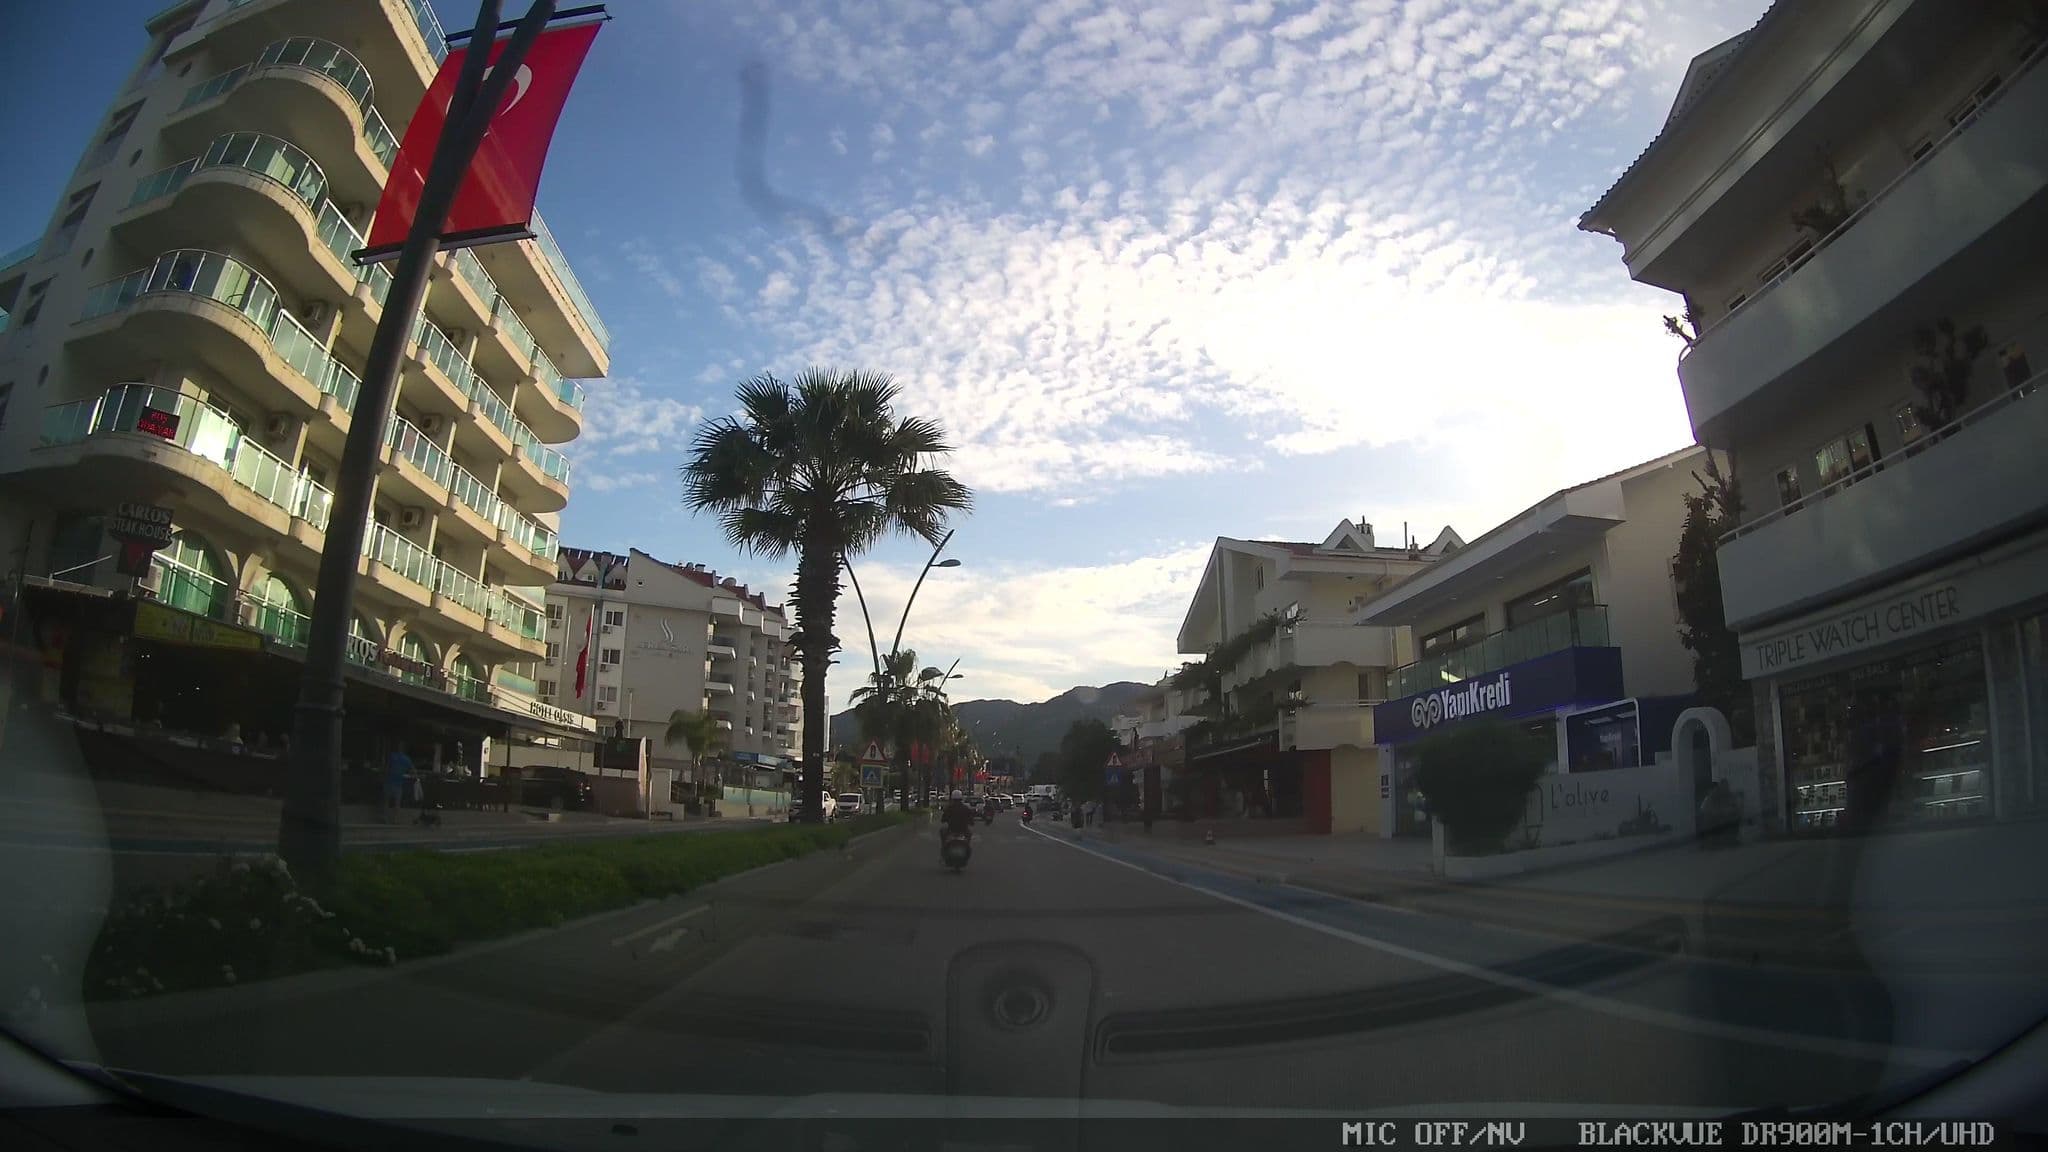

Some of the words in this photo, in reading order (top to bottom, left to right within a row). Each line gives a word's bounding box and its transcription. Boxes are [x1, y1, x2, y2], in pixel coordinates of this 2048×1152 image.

[118, 502, 171, 524] CARLOS
[1756, 634, 1805, 671] TRIPLE
[1809, 611, 1880, 654] WATCH
[1886, 586, 1960, 633] CENTER
